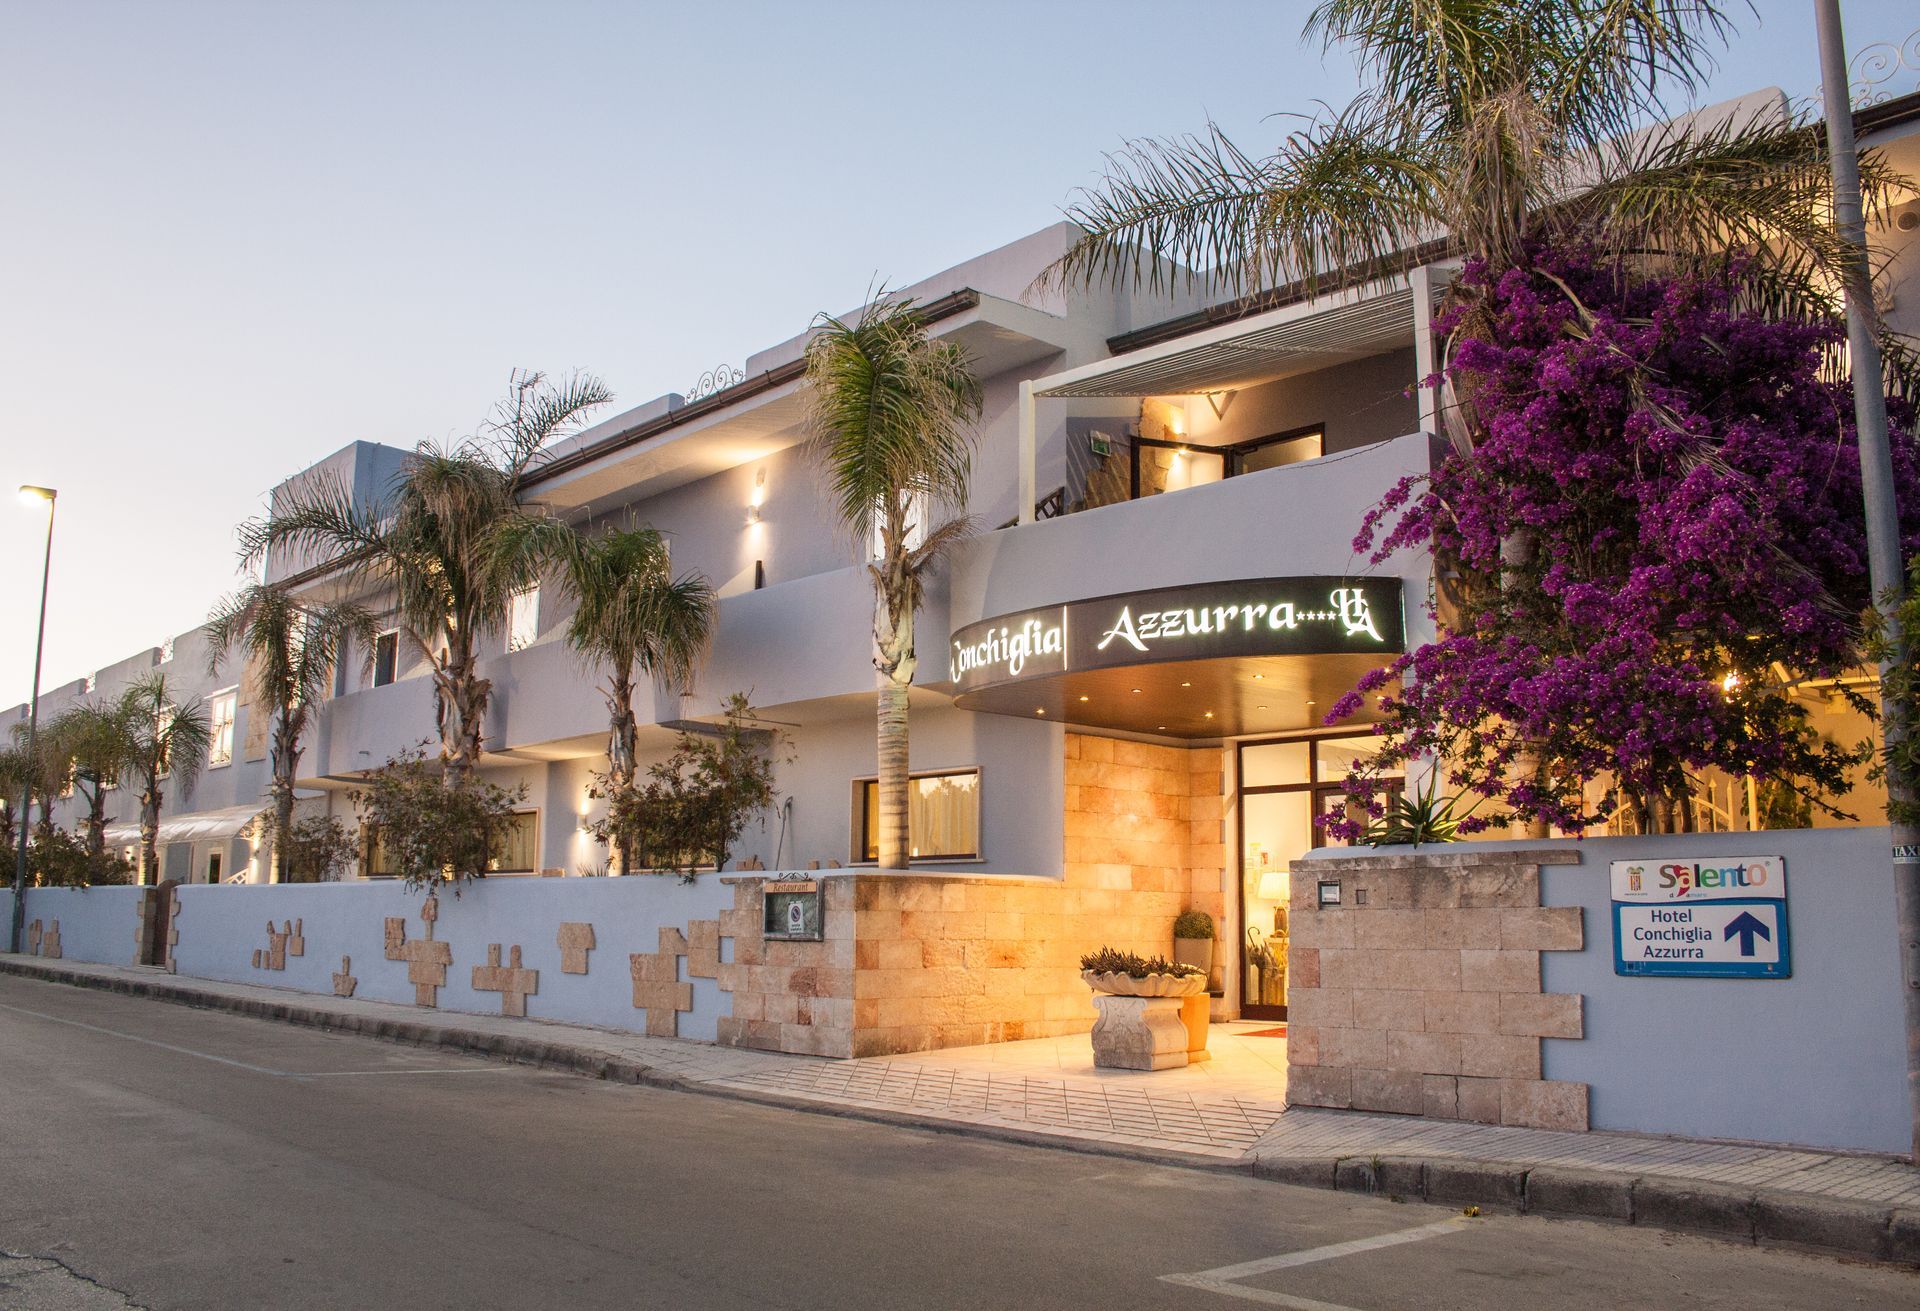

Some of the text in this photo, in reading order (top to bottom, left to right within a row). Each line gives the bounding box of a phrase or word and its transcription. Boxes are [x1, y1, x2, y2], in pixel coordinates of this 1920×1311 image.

[951, 619, 1062, 683] Conchiglia
[1098, 601, 1298, 651] Azzurra
[1659, 863, 1768, 890] Salento
[773, 883, 808, 892] Restaurant
[1651, 909, 1692, 923] Hotel
[1634, 926, 1712, 943] Conchiglia
[1643, 945, 1704, 958] Azzurra
